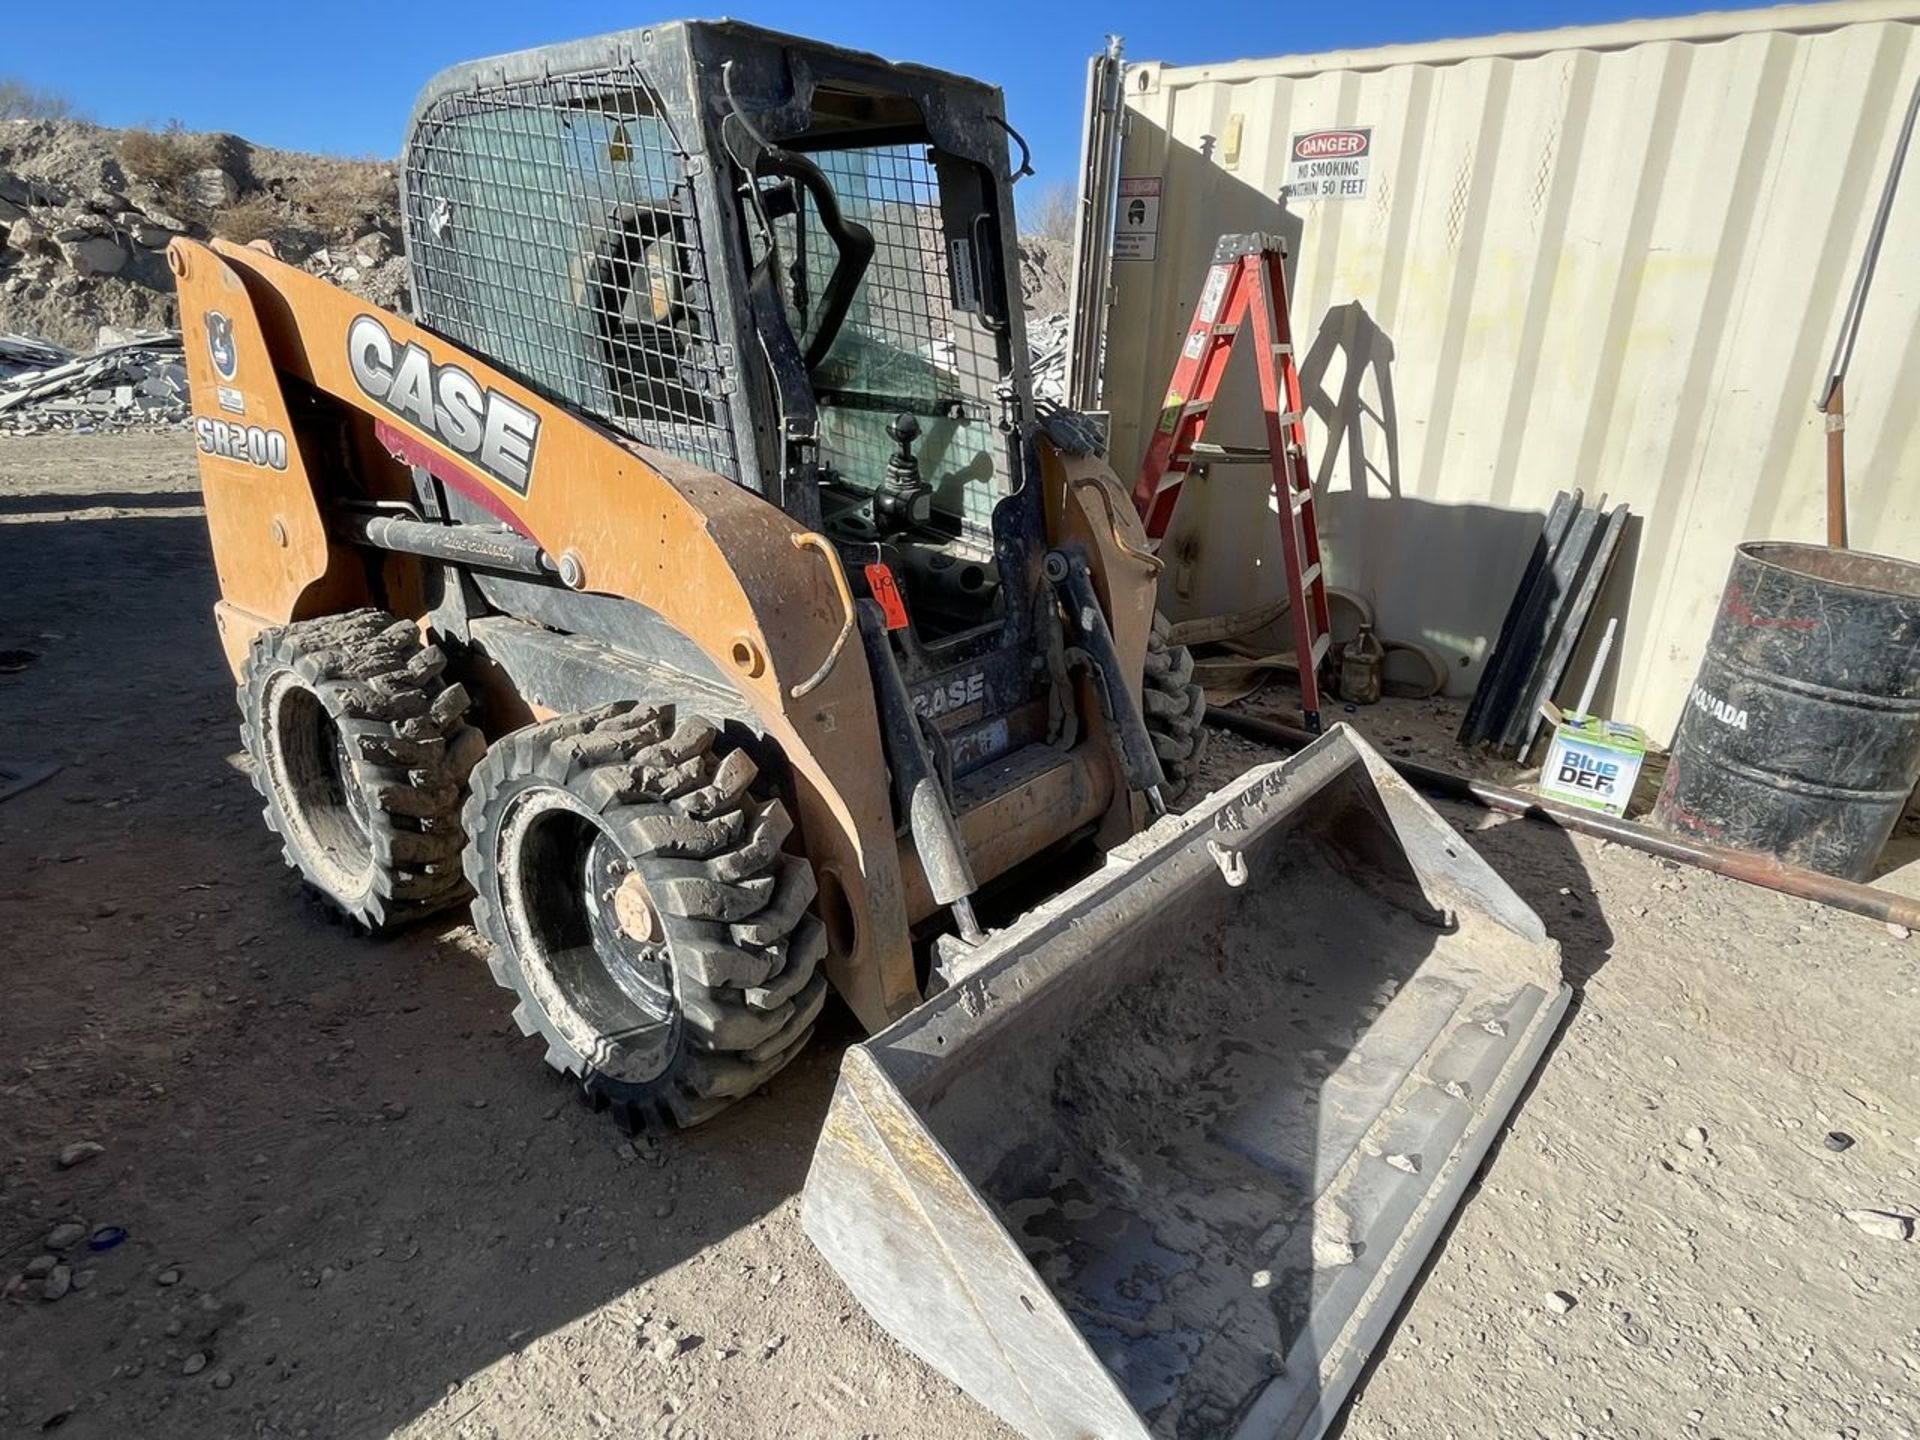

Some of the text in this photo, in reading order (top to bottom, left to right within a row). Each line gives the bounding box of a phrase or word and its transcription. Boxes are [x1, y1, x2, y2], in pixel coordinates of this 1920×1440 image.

[1302, 138, 1359, 154] DANGER
[1297, 160, 1359, 179] NO SMOKING
[1322, 180, 1336, 195] 50
[1341, 179, 1365, 195] FEET
[349, 314, 540, 493] CASE
[196, 416, 287, 470] SR200
[912, 672, 985, 719] CASE
[1558, 766, 1615, 791] DEF
